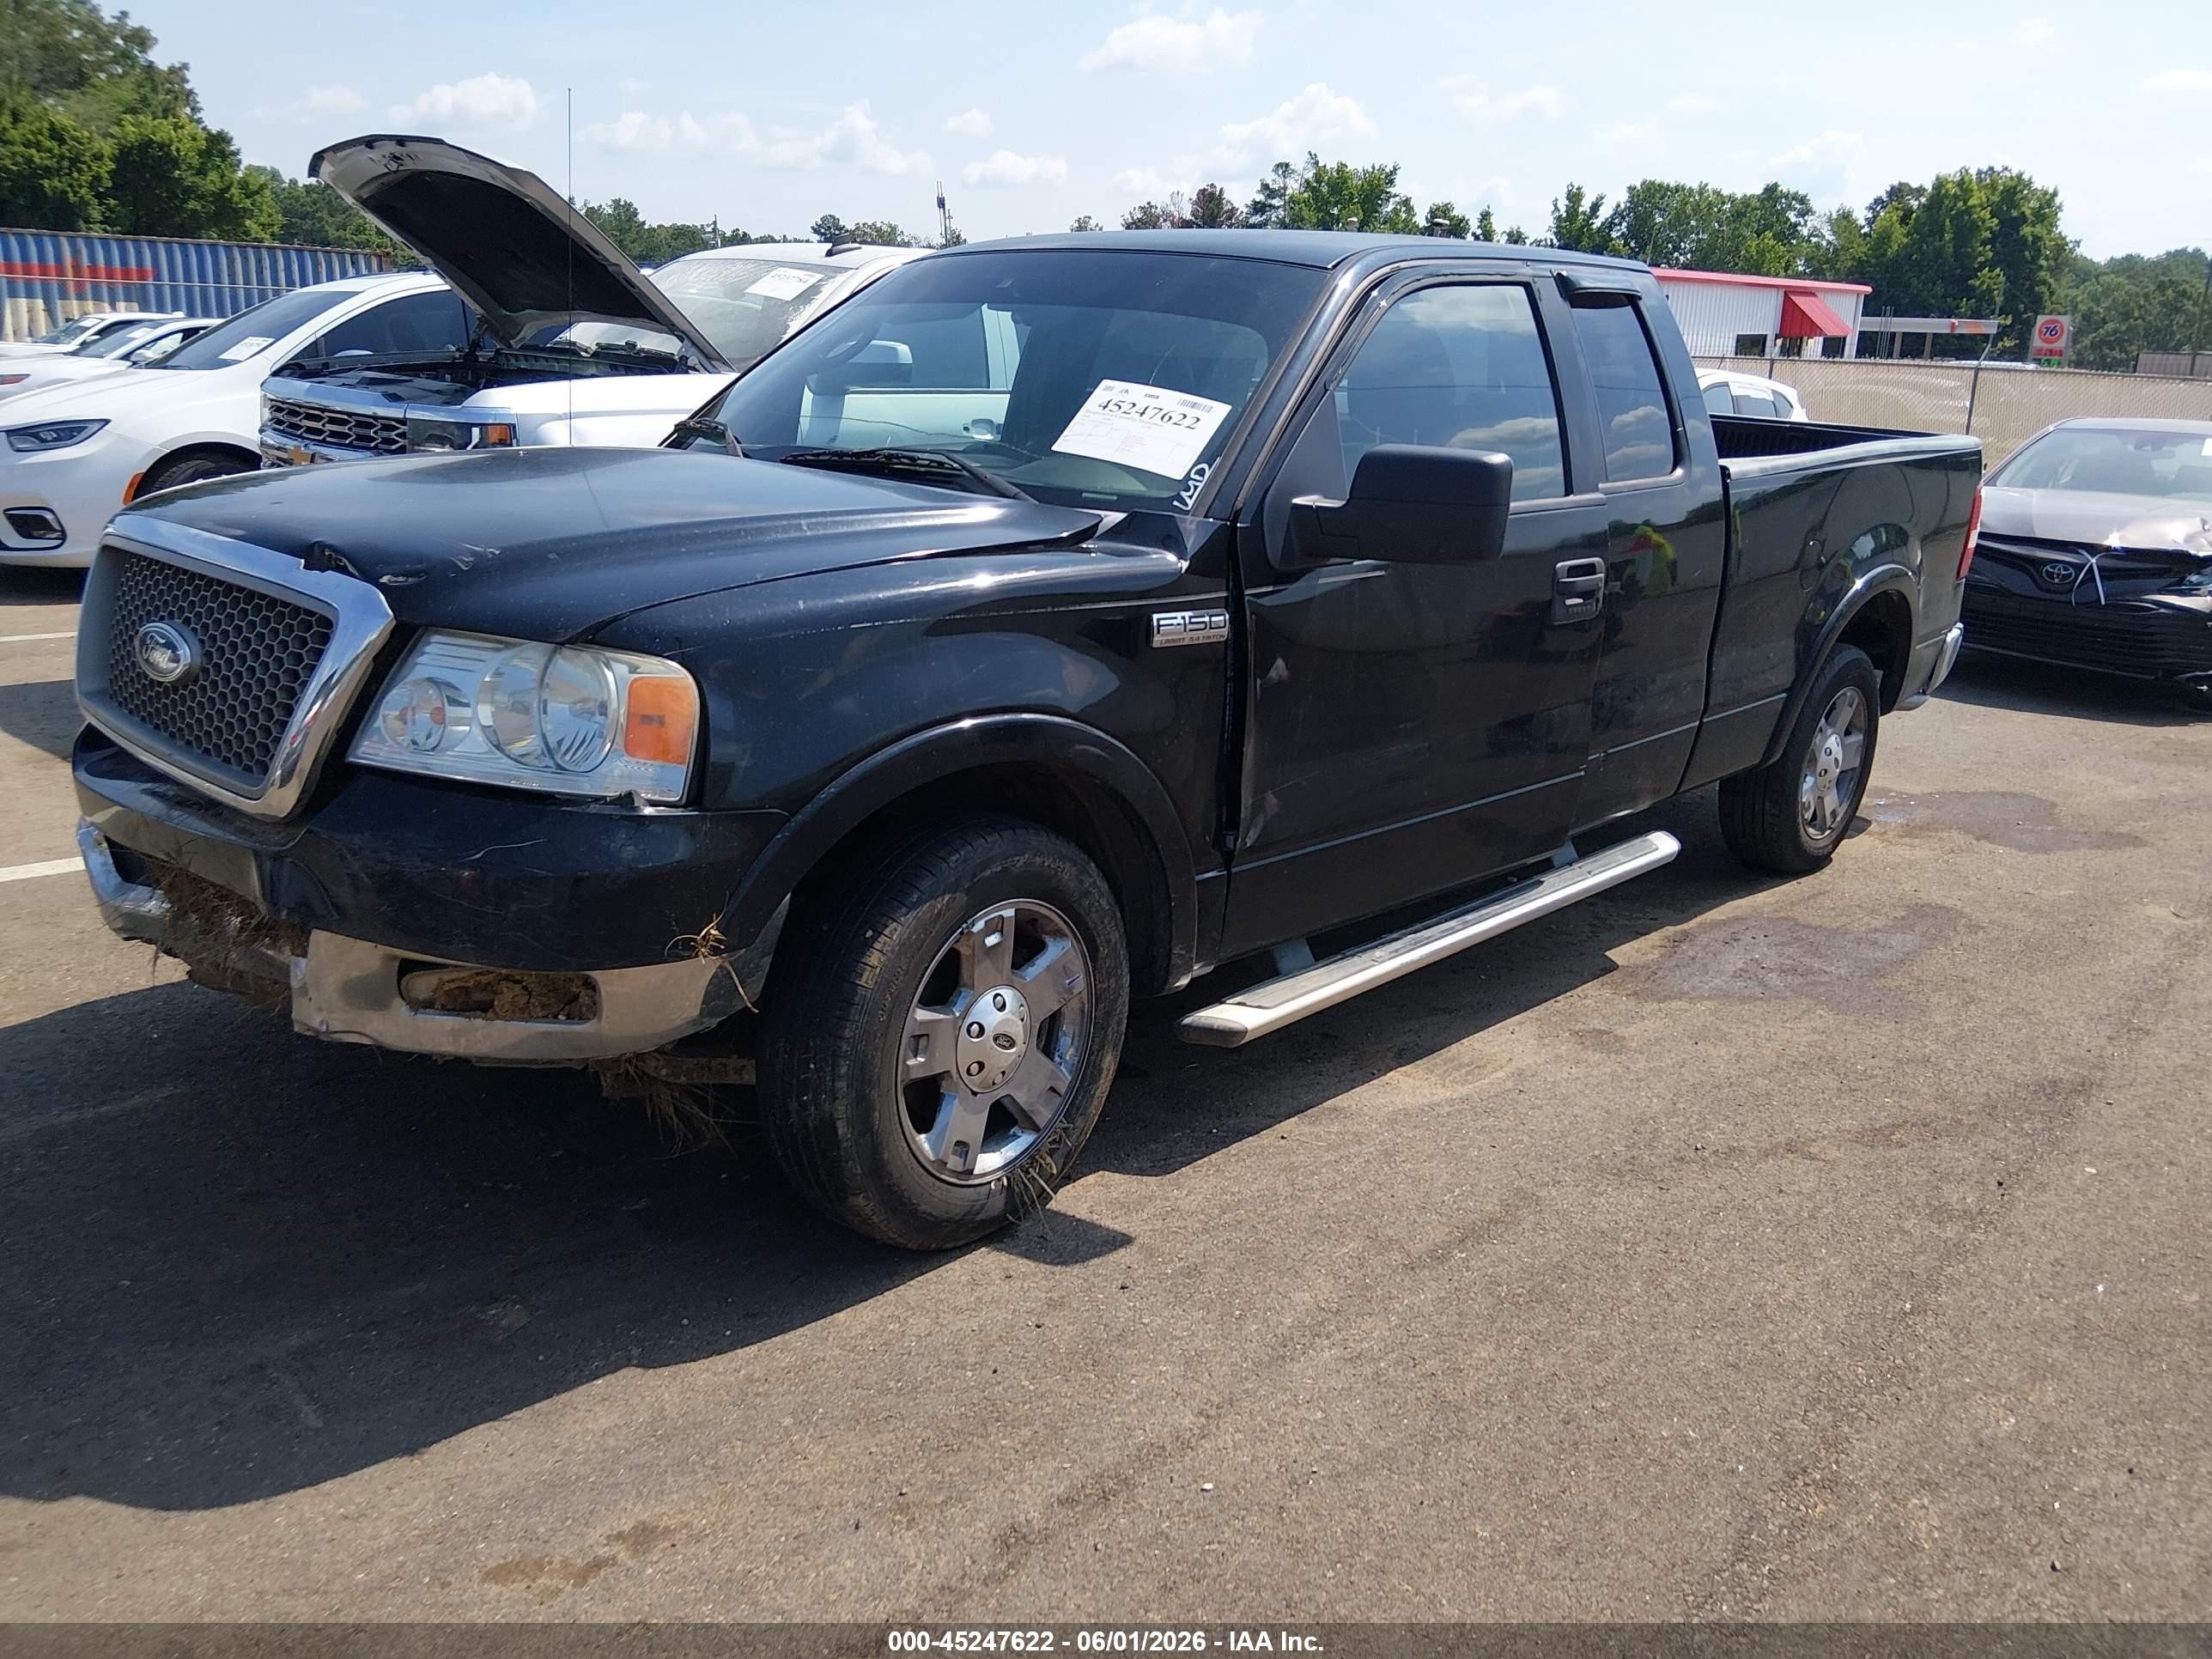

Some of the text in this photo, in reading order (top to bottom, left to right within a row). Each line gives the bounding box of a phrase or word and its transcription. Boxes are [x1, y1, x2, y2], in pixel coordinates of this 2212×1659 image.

[2043, 325, 2058, 337] 76
[1097, 398, 1201, 430] 45247622
[142, 632, 177, 668] Ford
